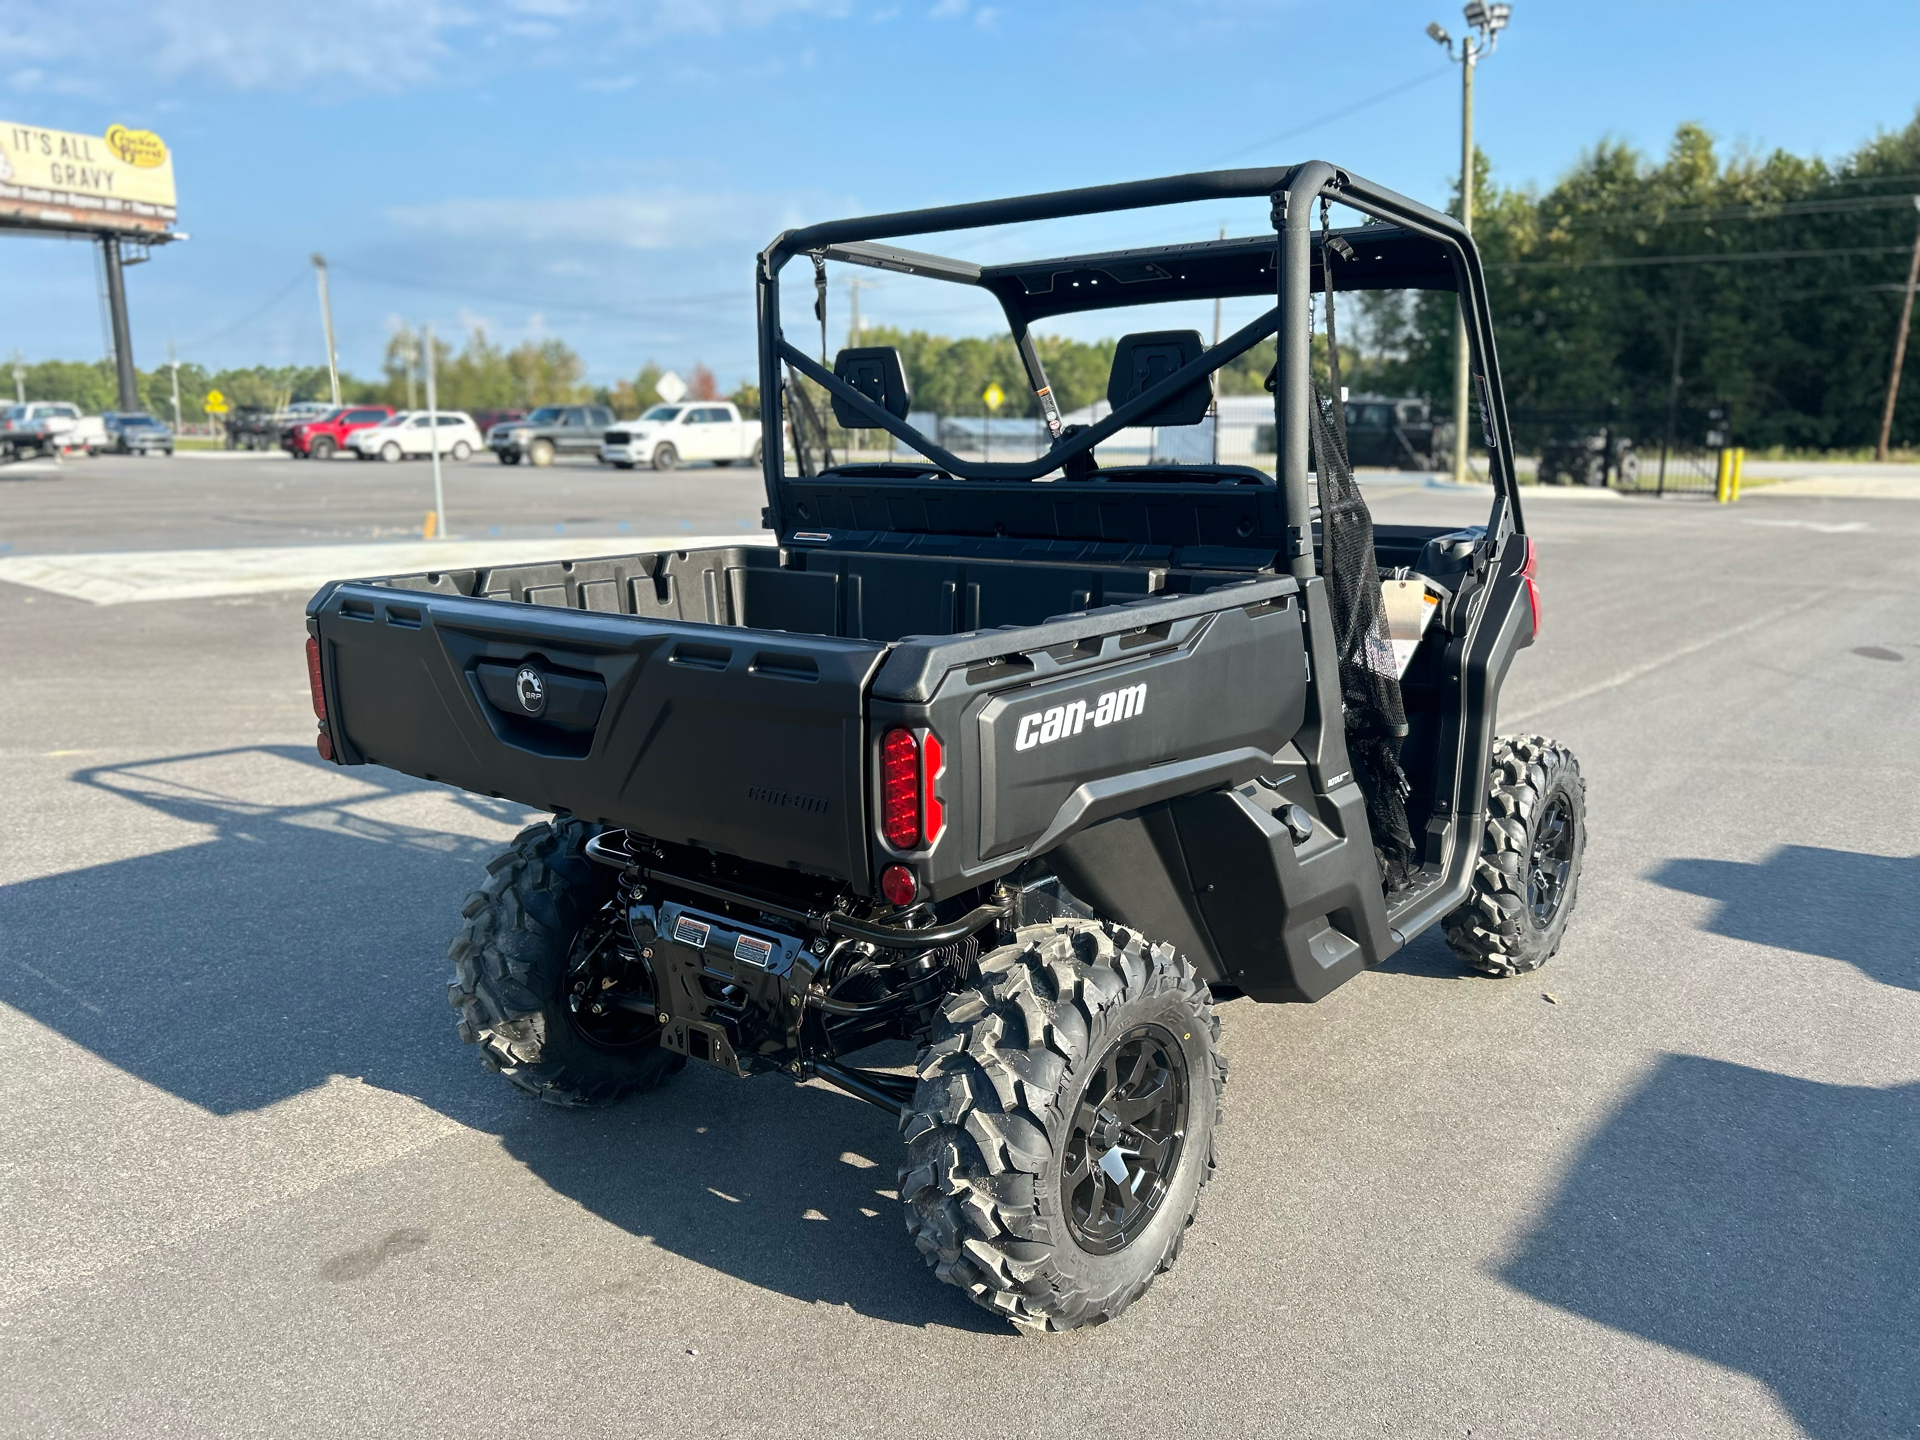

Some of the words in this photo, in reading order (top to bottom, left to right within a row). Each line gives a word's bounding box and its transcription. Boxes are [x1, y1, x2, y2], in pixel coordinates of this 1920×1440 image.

[13, 128, 52, 156] IT'S
[61, 136, 95, 162] ALL
[50, 161, 115, 191] GRAVY
[525, 691, 542, 700] BRP
